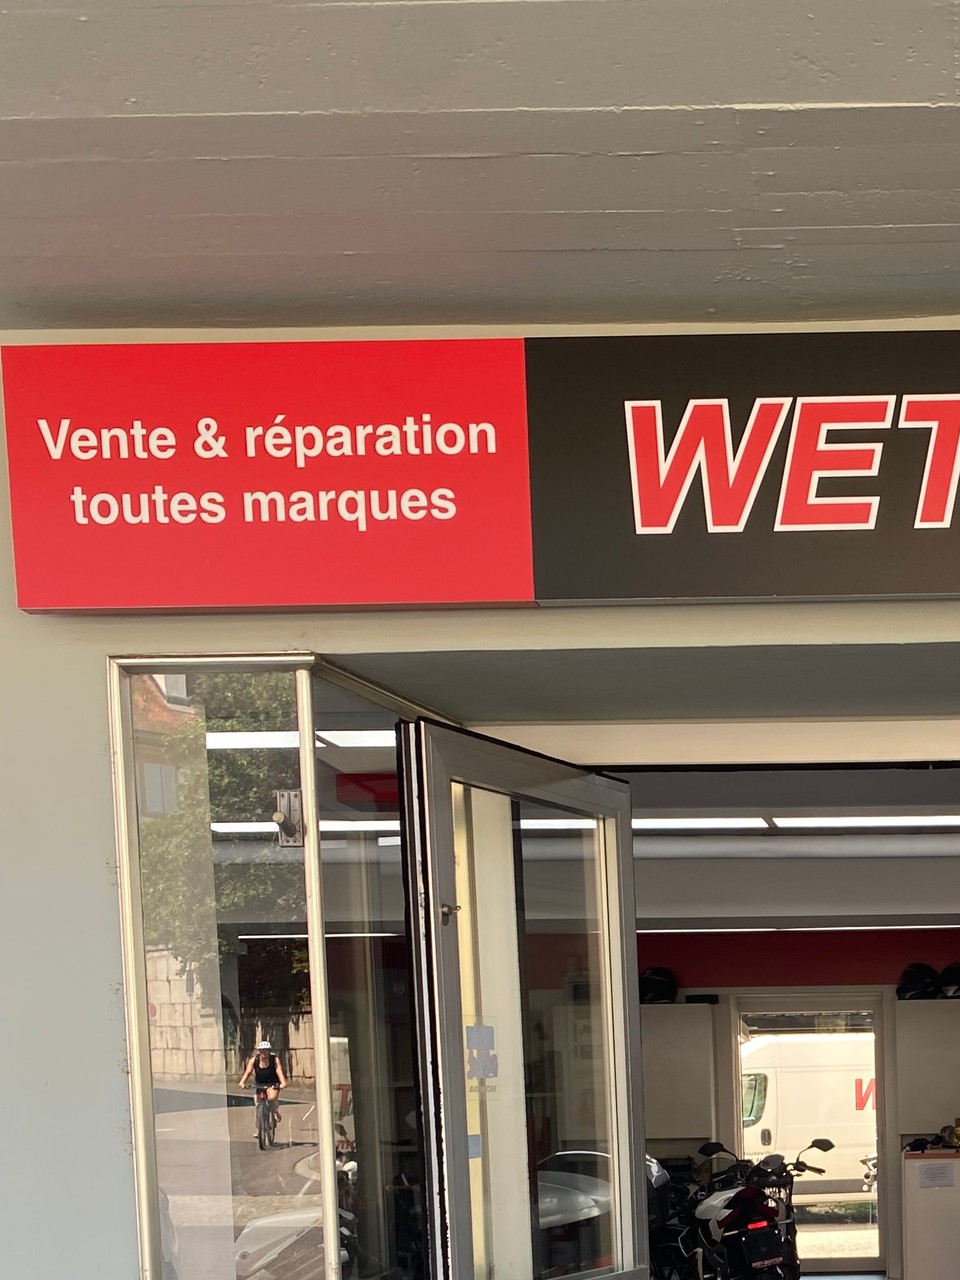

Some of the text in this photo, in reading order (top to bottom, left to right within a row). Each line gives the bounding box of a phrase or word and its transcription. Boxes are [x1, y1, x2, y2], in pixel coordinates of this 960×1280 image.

[37, 413, 497, 467] Vente & réparation
[70, 484, 457, 532] toutes marques
